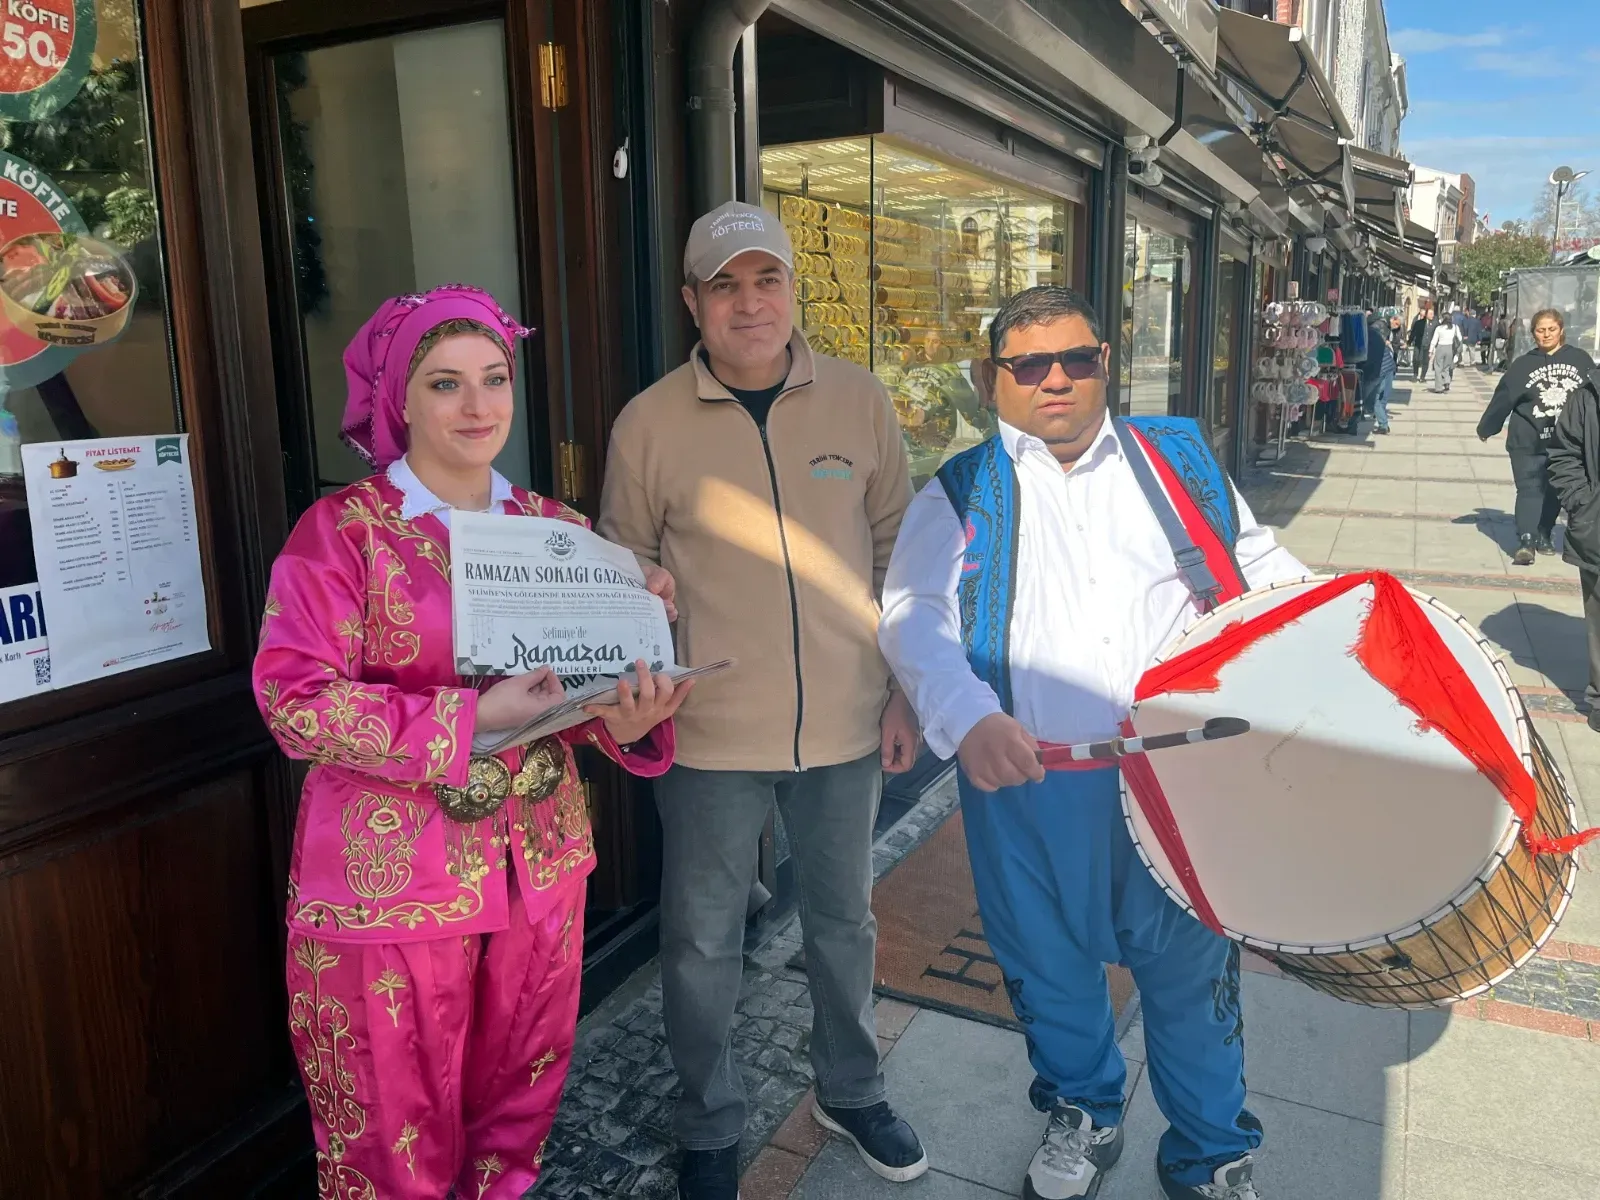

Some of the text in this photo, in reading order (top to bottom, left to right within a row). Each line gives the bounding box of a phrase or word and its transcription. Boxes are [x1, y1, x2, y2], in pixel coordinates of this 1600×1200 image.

[8, 0, 69, 33] KÖFTE
[4, 159, 71, 220] KÖFTE
[711, 220, 765, 239] KÖFTECİSİ
[86, 446, 141, 457] FİYAT LİSTEMİZ
[464, 562, 530, 583] RAMAZAN
[535, 565, 589, 584] SOKAĞI
[542, 625, 587, 641] Selimiye'de
[504, 632, 627, 671] Ramazan
